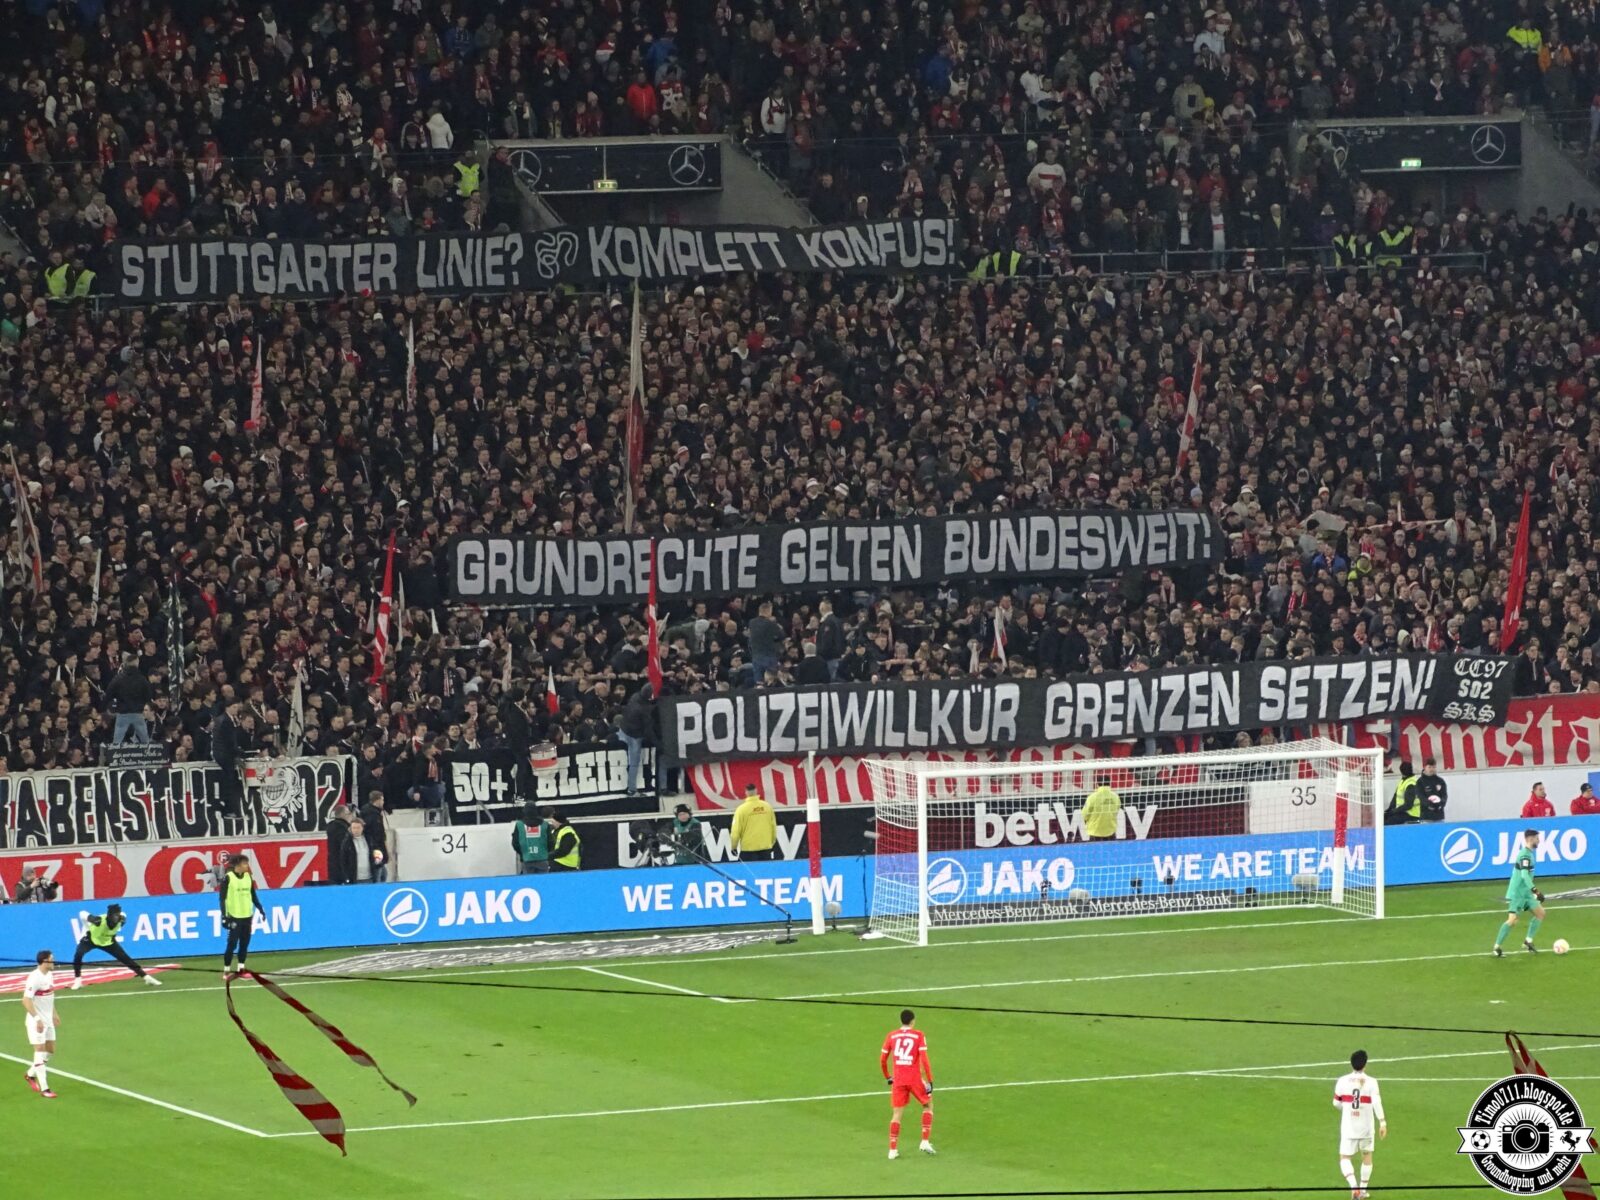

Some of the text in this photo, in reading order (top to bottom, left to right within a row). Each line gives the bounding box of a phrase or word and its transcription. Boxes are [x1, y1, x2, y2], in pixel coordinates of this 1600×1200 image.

[121, 218, 954, 297] STUTTGARTER LINIE? KOMPLETT KONFUS!
[456, 512, 1211, 596] GRUNDRECHTE GELTEN BUNDESWEIT!
[1454, 658, 1508, 679] CC97
[676, 658, 1438, 760] POLIZEIWILLKÜR GRENZEN SETZEN!
[1292, 786, 1317, 806] 35
[442, 833, 468, 853] 34
[1492, 828, 1587, 865] JAKO
[977, 857, 1075, 896] JAKO
[1153, 853, 1202, 882] WE
[1210, 850, 1272, 879] ARE
[438, 888, 541, 926] JAKO
[622, 884, 674, 912] WE
[681, 879, 746, 910] ARE
[132, 911, 199, 941] ARE
[207, 905, 300, 937] TAM
[894, 1038, 914, 1060] 42
[1352, 1089, 1360, 1110] 3
